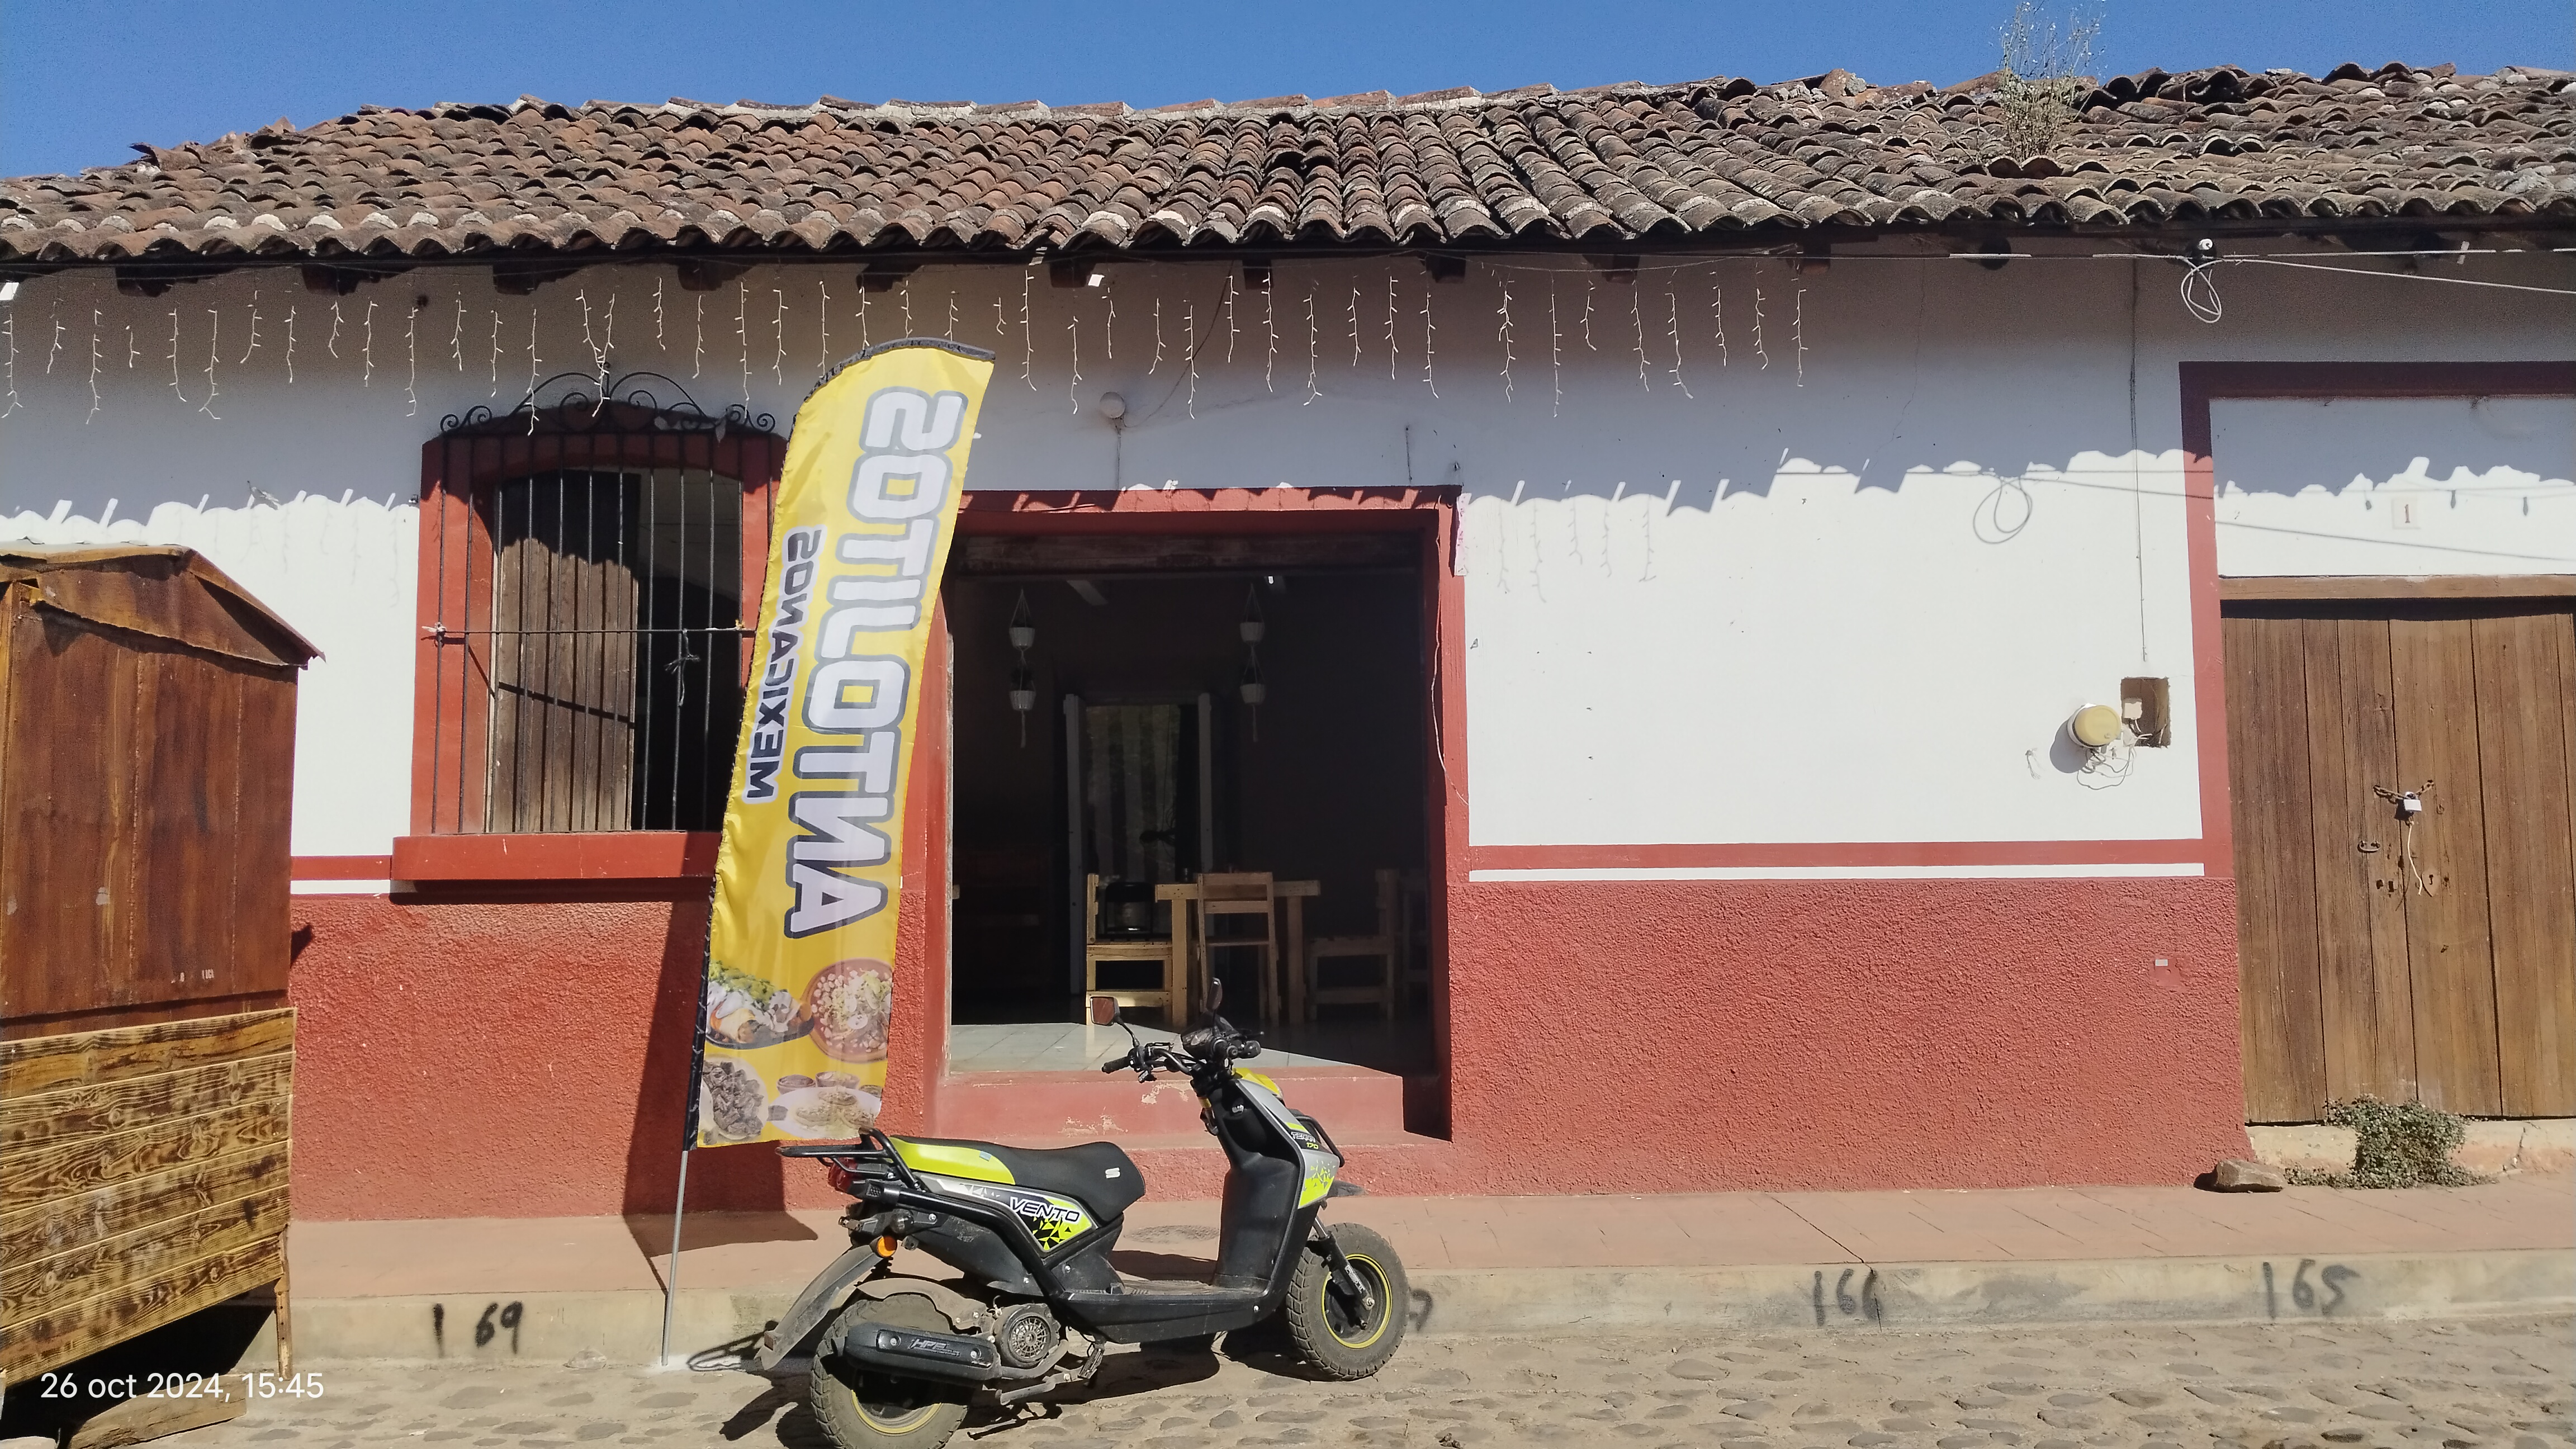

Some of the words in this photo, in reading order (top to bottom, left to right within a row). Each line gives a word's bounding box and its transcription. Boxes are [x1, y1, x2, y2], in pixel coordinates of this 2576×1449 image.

[1291, 1131, 1316, 1143] TERRA
[1010, 1196, 1081, 1223] VENTO
[2262, 1259, 2361, 1320] 165
